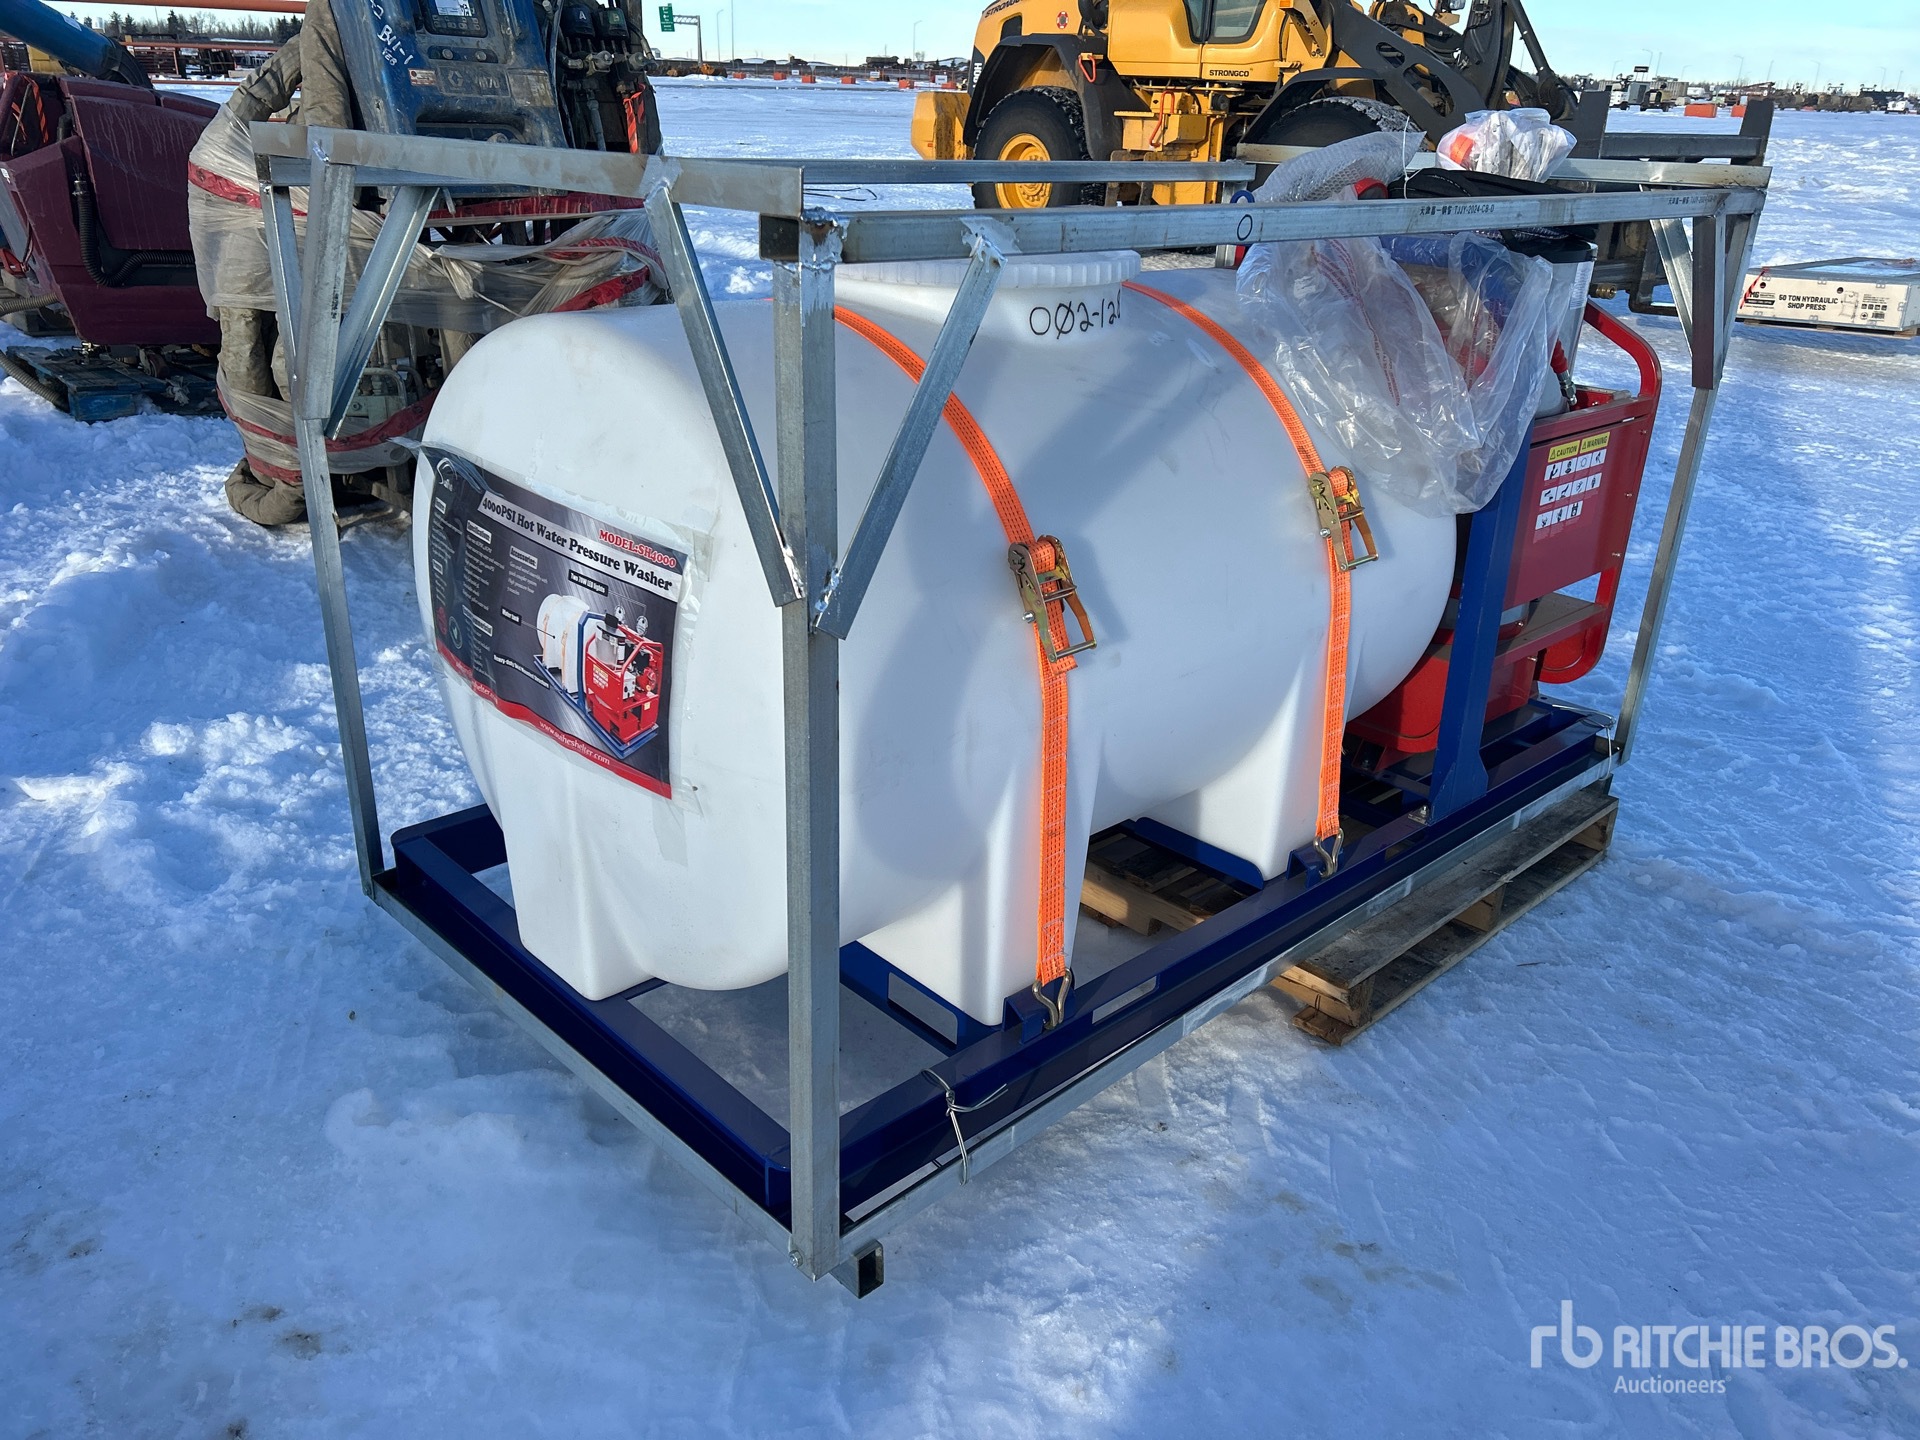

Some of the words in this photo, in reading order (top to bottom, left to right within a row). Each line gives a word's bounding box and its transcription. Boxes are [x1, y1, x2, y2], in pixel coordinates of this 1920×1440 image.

[579, 10, 587, 20] A
[1209, 69, 1250, 77] STRONGCO
[1802, 295, 1839, 304] HYDRAULIC
[1805, 303, 1827, 311] PRESS
[1586, 435, 1608, 449] WARNING
[1556, 445, 1578, 457] CAUTION
[482, 498, 516, 523] 4000PSI
[517, 513, 535, 532] Hot
[536, 522, 567, 548] Water
[568, 537, 621, 571] Pressure
[623, 559, 673, 591] Washer
[599, 529, 677, 568] MODEL:SH4000
